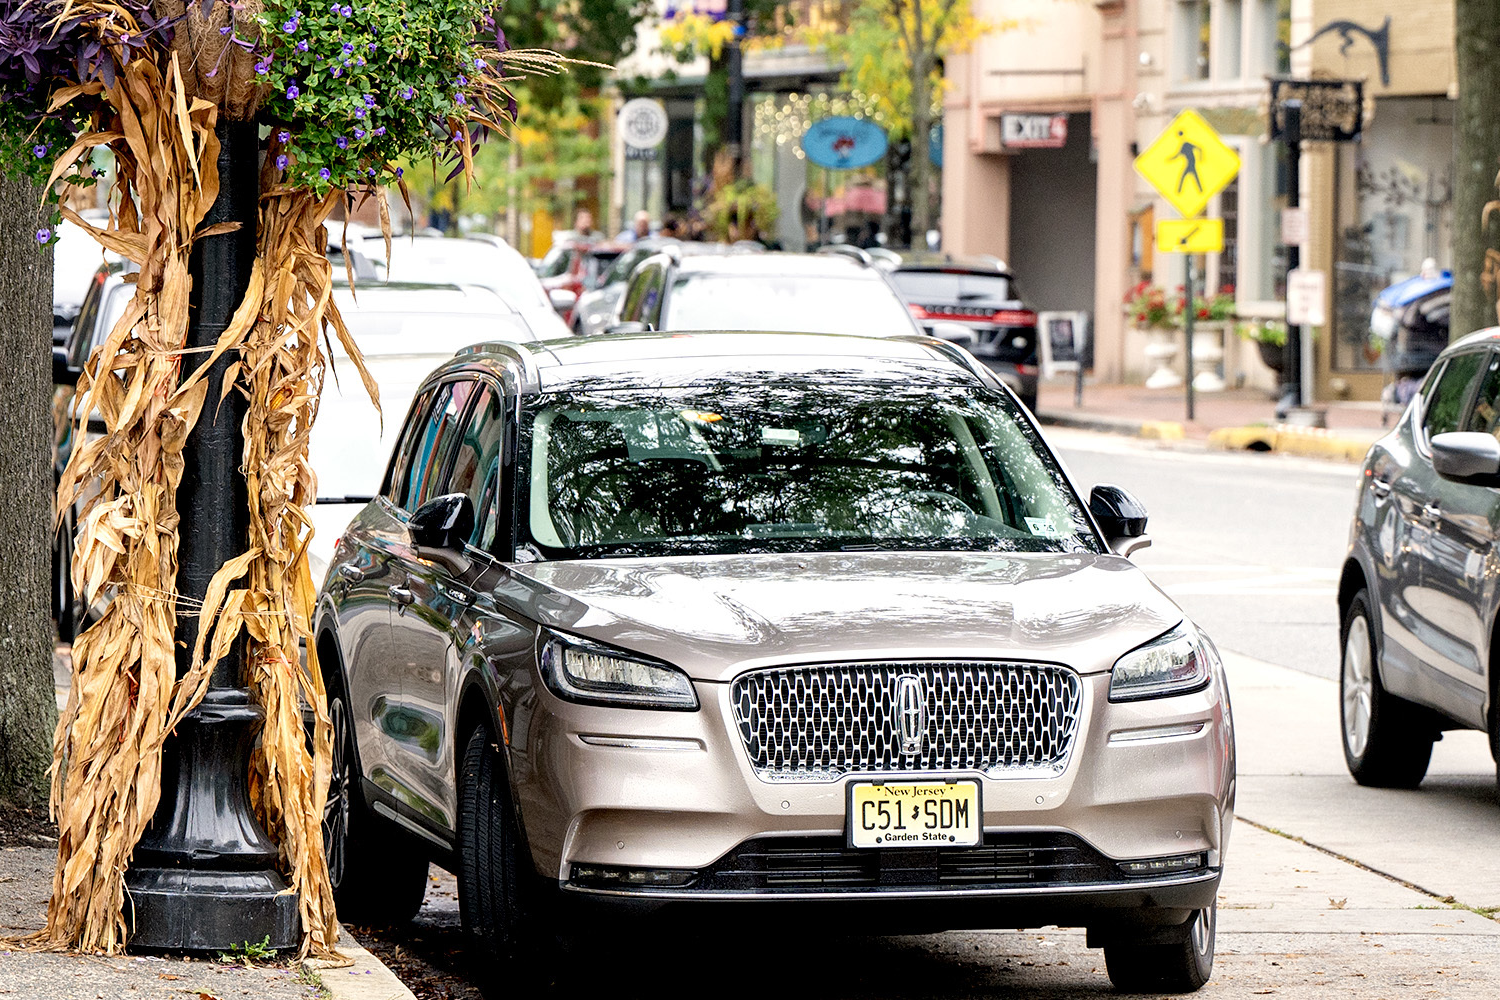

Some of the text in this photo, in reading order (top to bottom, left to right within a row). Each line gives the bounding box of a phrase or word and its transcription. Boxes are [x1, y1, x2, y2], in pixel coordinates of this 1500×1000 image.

[884, 786, 946, 798] New Jersey
[862, 799, 969, 831] C51 SDM
[885, 832, 947, 842] Garden State
